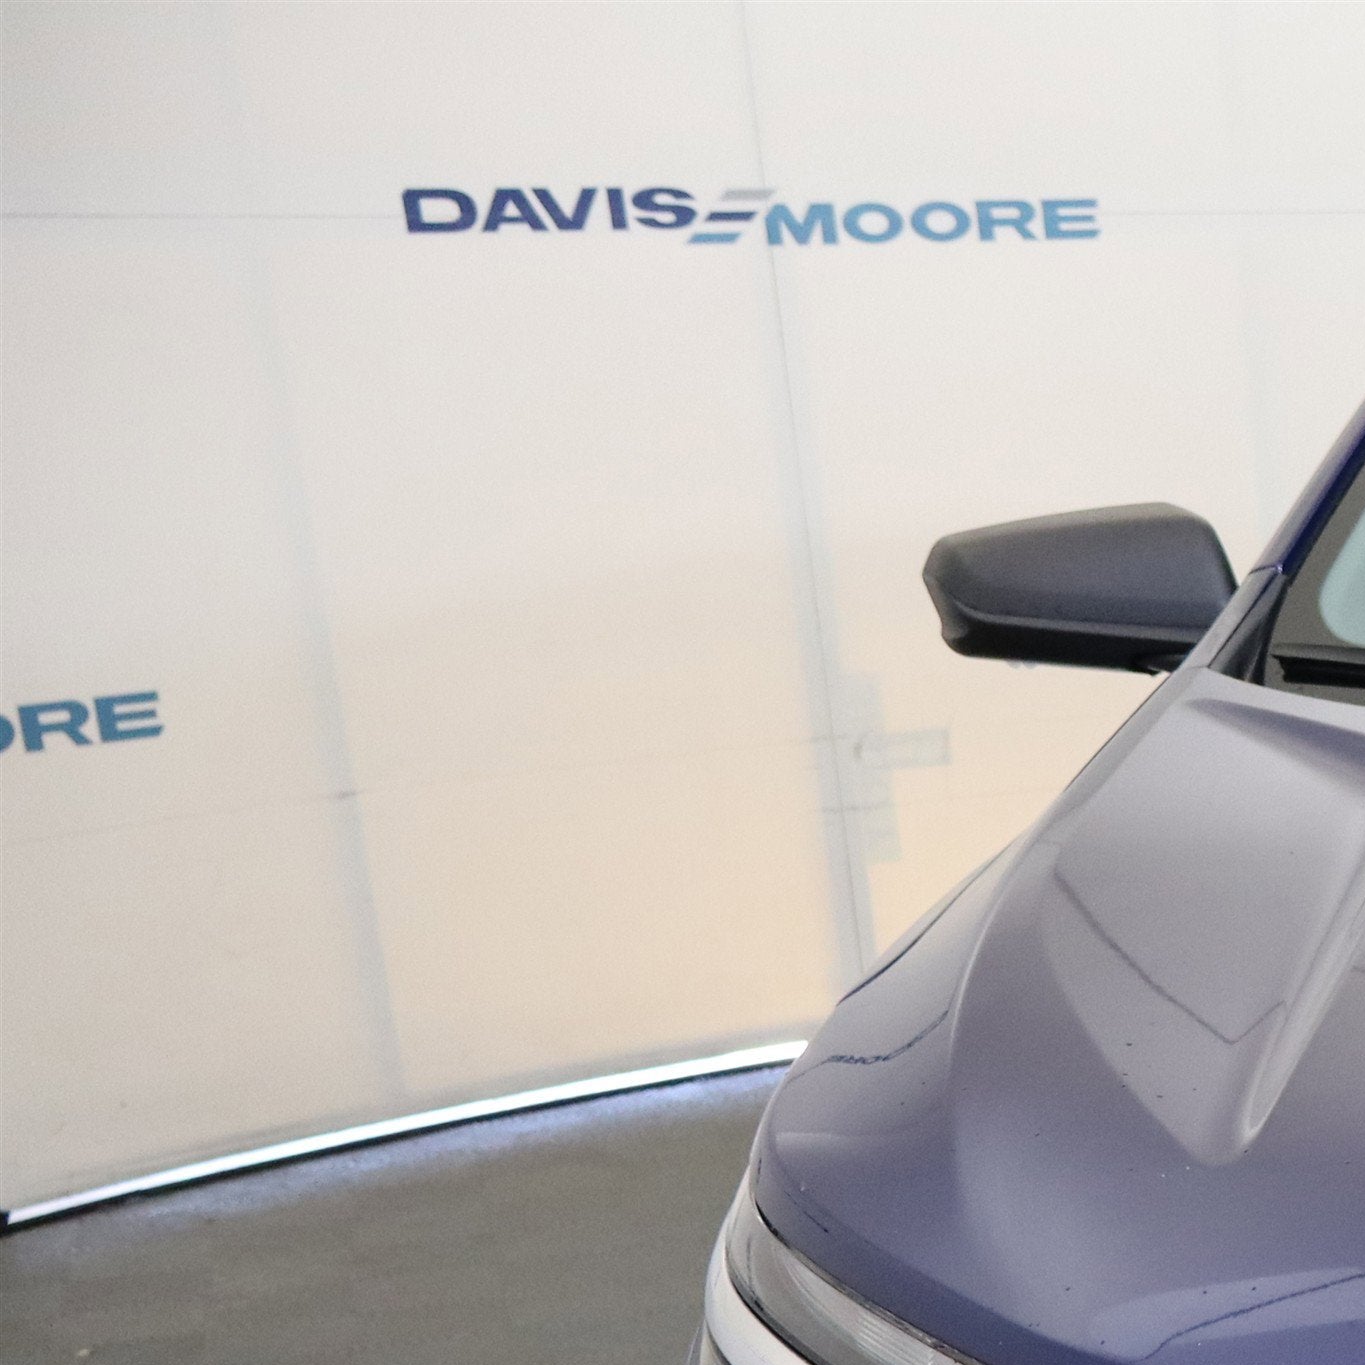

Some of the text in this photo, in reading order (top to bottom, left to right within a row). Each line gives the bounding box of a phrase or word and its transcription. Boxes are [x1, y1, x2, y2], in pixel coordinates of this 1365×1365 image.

[402, 187, 1101, 246] DAVIS MOORE
[0, 690, 164, 753] RE
